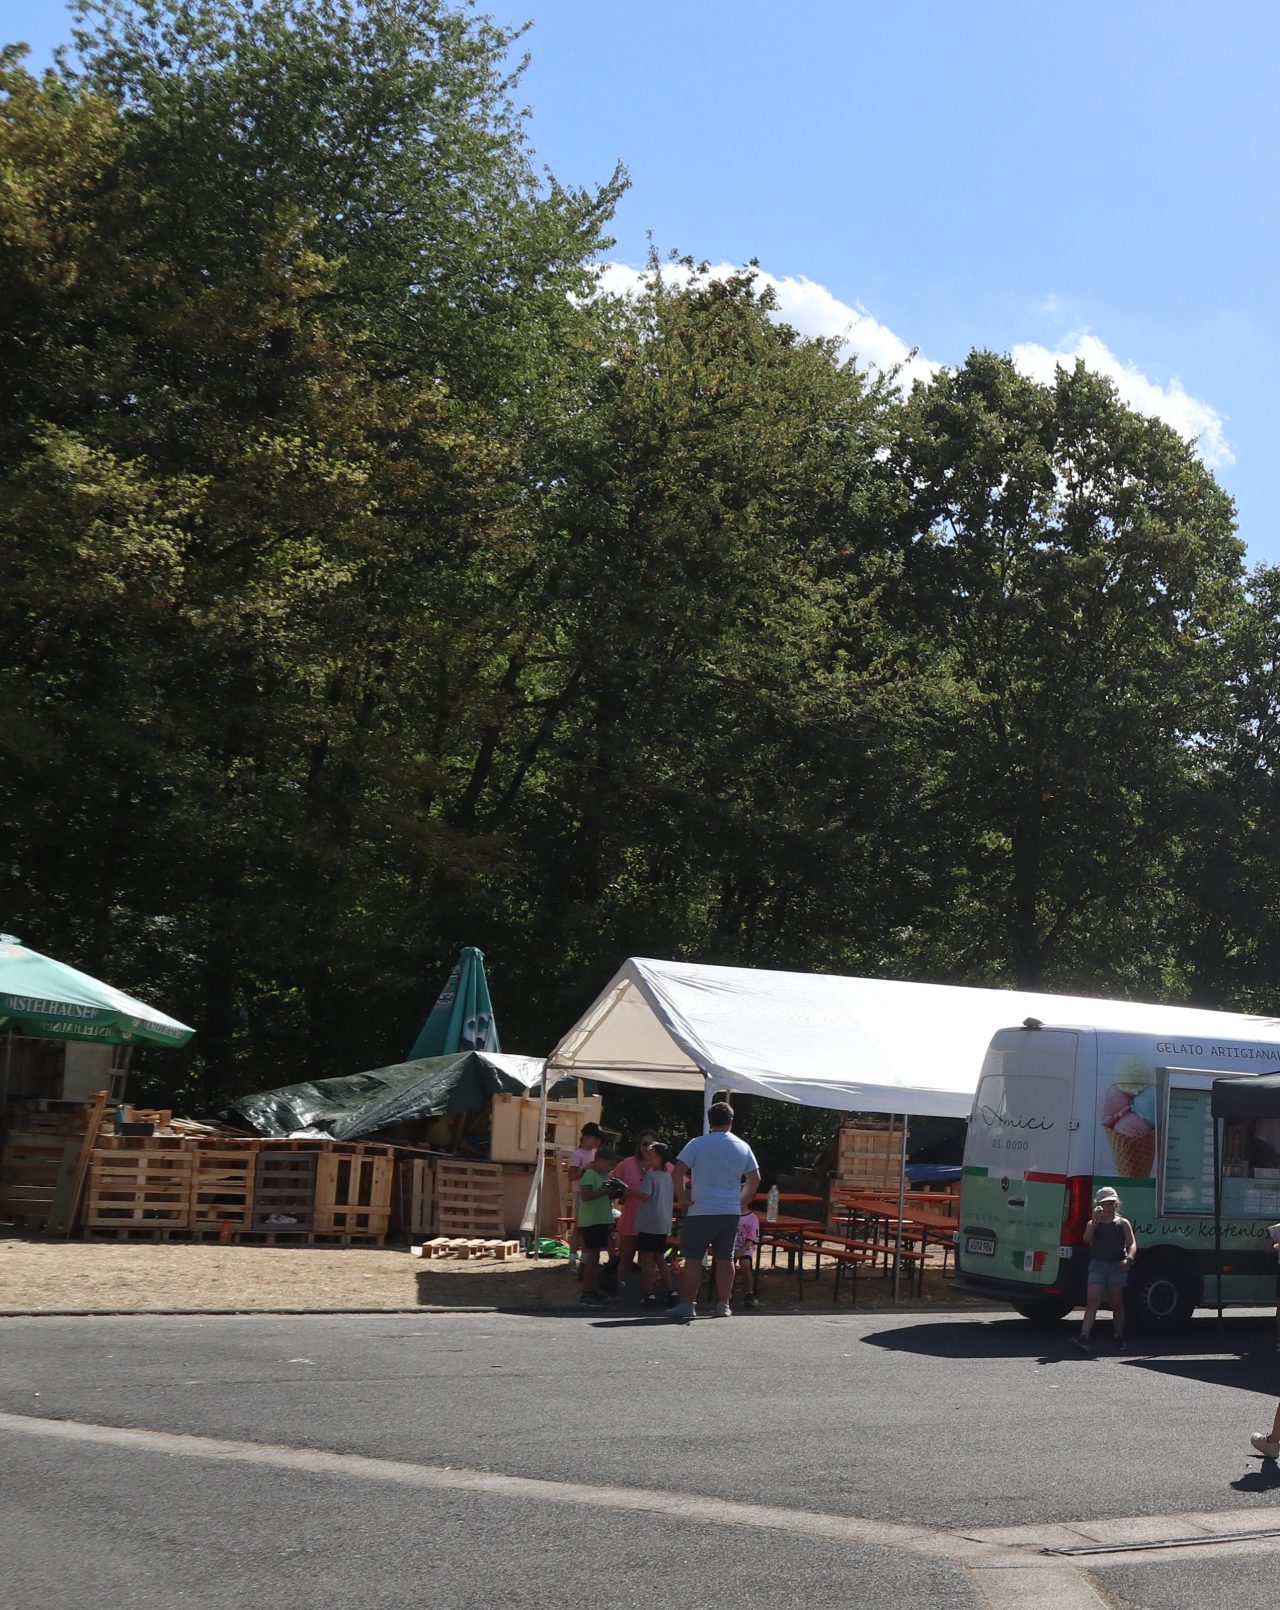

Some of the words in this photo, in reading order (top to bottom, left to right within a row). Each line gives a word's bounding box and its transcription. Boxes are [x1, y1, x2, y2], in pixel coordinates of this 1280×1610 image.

[1156, 1042, 1203, 1056] GELATO
[981, 1089, 1054, 1131] Amici
[1162, 1223, 1193, 1237] uns
